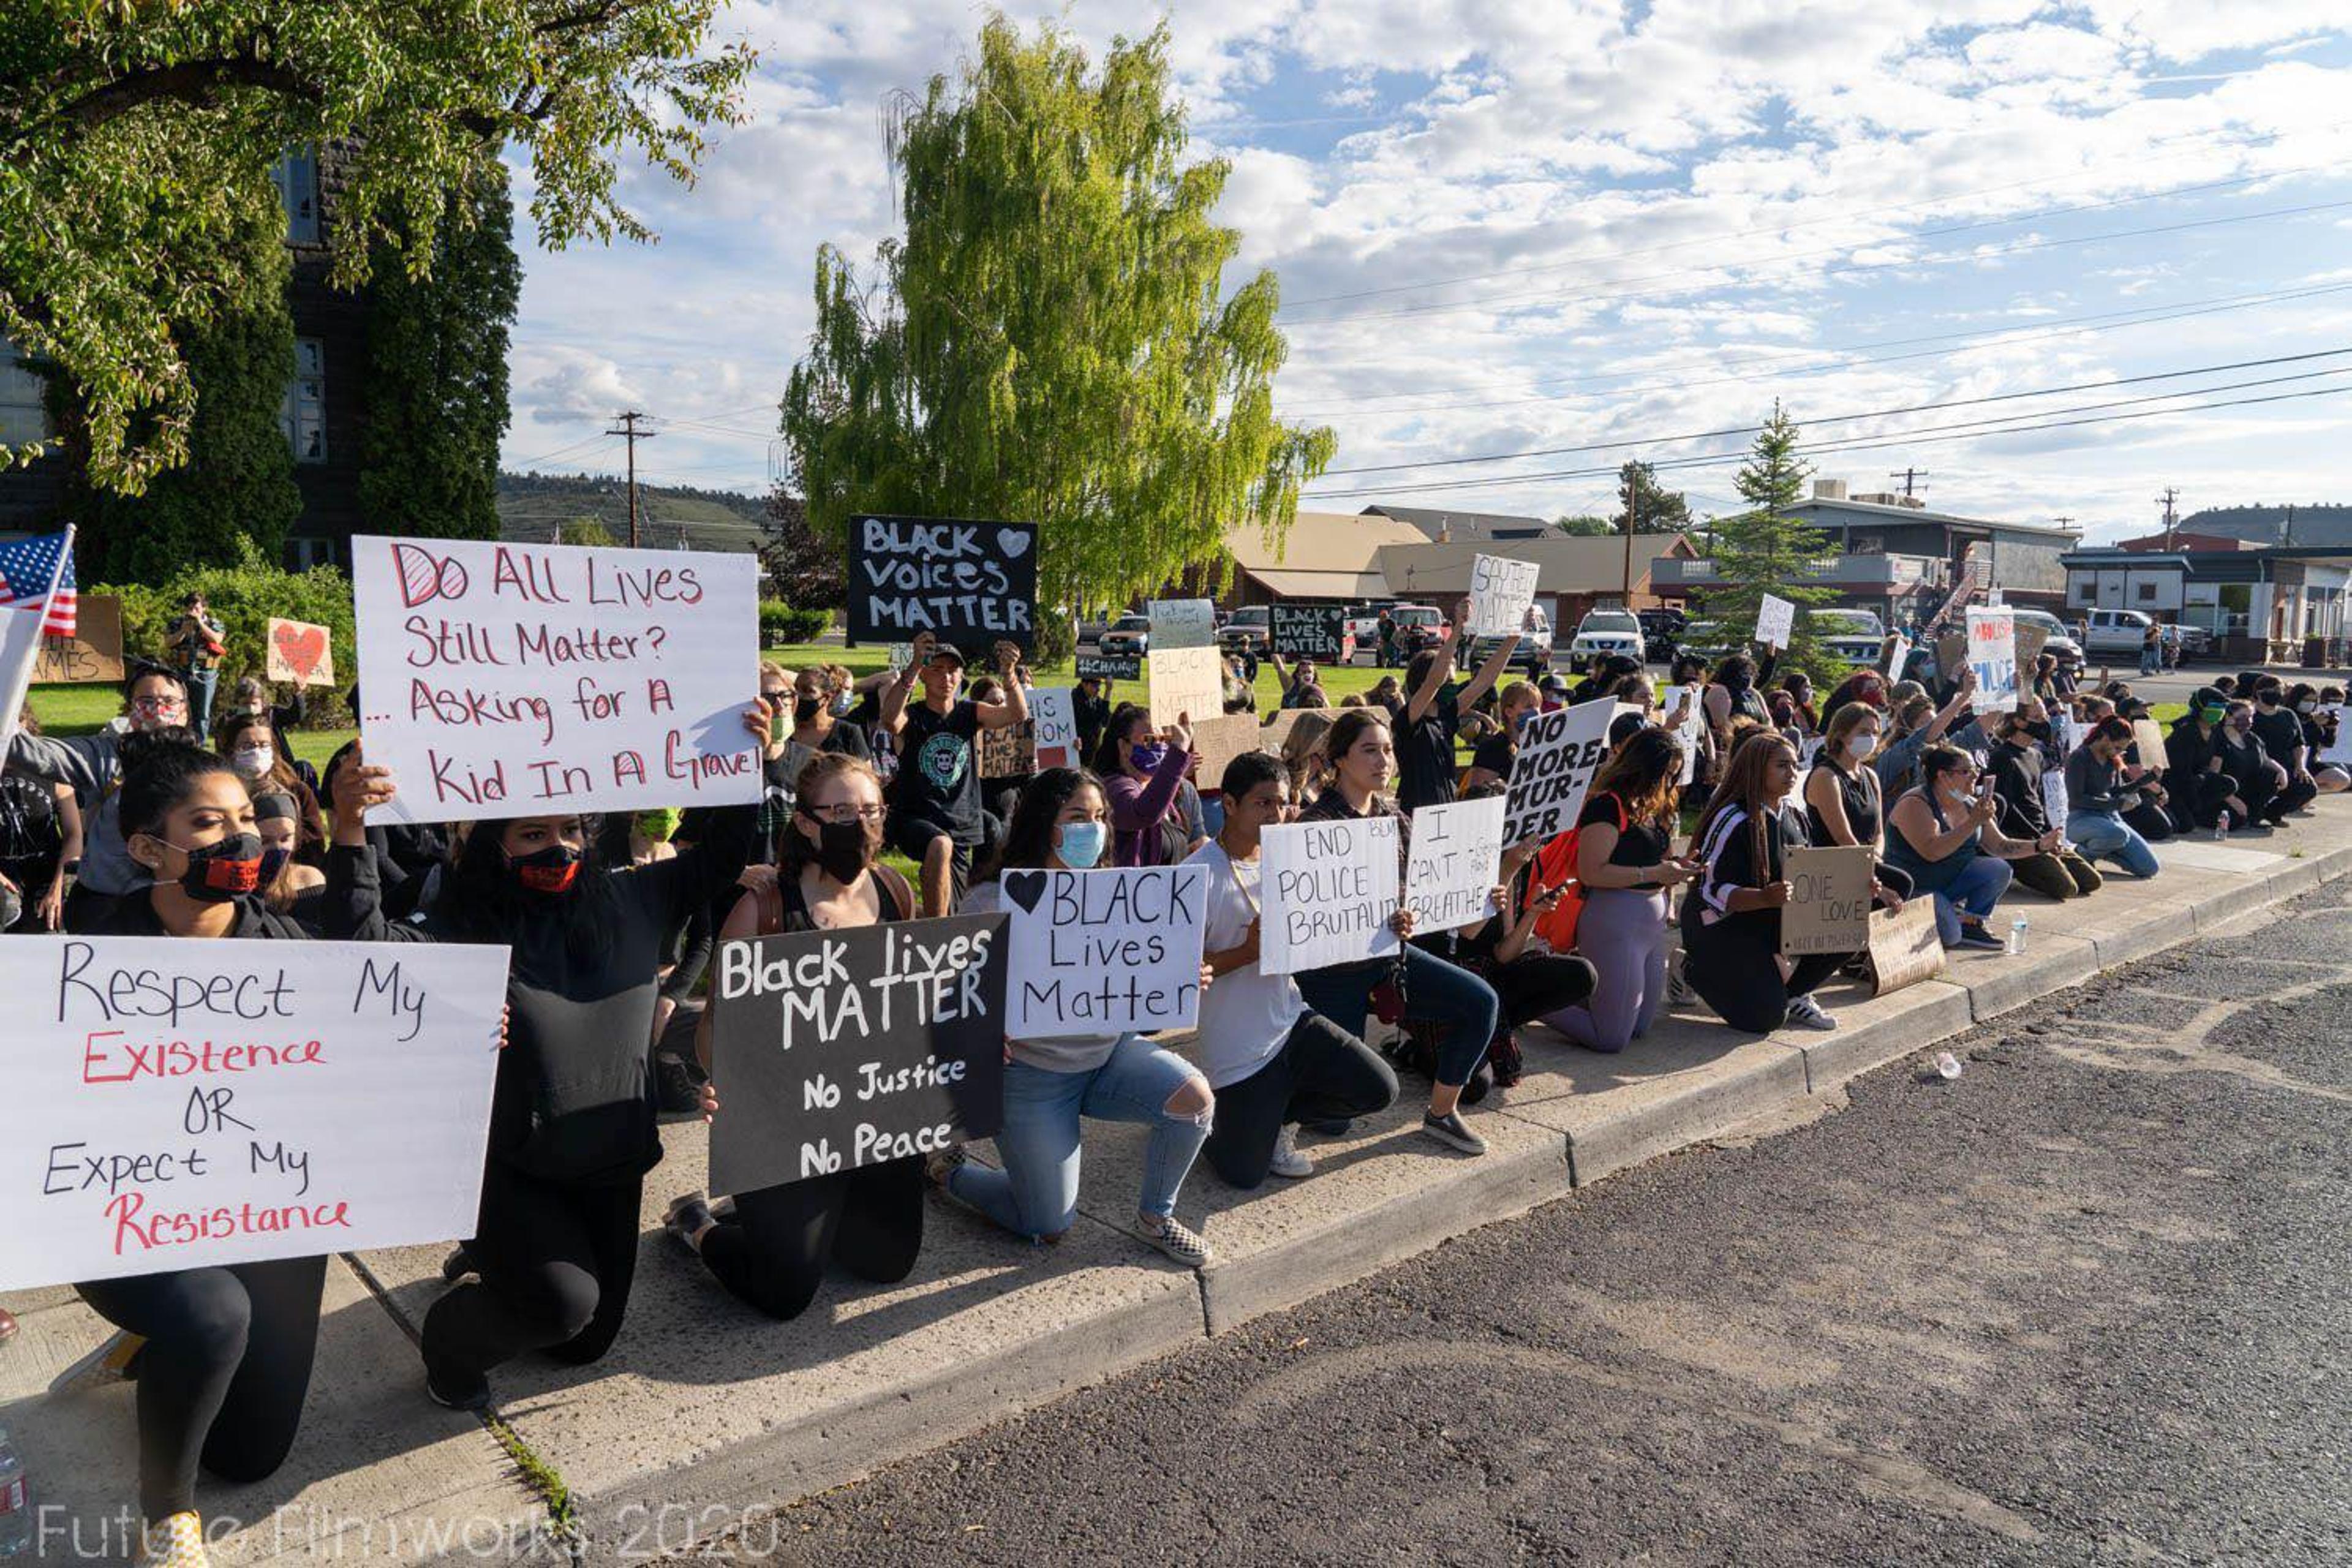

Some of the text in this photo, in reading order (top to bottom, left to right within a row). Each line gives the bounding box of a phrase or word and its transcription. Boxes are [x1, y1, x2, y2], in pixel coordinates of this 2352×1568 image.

[864, 519, 984, 556] BLACK
[390, 543, 704, 609] Do All Lives
[1475, 556, 1510, 592] SAY
[870, 595, 1031, 631] MATTER
[1274, 608, 1328, 624] BLACK
[1276, 624, 1325, 638] LIVES
[405, 615, 666, 667] Still Matter?
[1275, 635, 1340, 653] MATTER
[411, 677, 552, 746] Asking
[572, 677, 626, 722] for
[648, 678, 674, 717] A
[1523, 714, 1567, 750] NO
[428, 748, 507, 804] Kid
[527, 761, 593, 799] In
[612, 750, 646, 787] A
[1512, 738, 1604, 786] MORE
[1506, 774, 1583, 816] MUR-
[1305, 826, 1352, 859] END
[1427, 810, 1449, 843] I
[1502, 807, 1560, 846] DER
[1053, 871, 1196, 927] BLACK
[1278, 866, 1368, 903] POLICE
[1409, 886, 1483, 925] BREATHE
[1795, 874, 1833, 903] ONE
[1821, 900, 1867, 921] LOVE
[722, 939, 848, 999] Black
[1051, 930, 1165, 967] Lives
[59, 942, 426, 1042] Respect My
[782, 968, 986, 1049] MATTER
[1023, 976, 1198, 1023] Matter
[83, 1031, 327, 1084] Existence
[804, 1055, 966, 1110] No Justice
[184, 1086, 255, 1134] OR
[43, 1141, 310, 1196] Expect My
[801, 1122, 952, 1179] No Peace
[105, 1192, 351, 1256] Resistance
